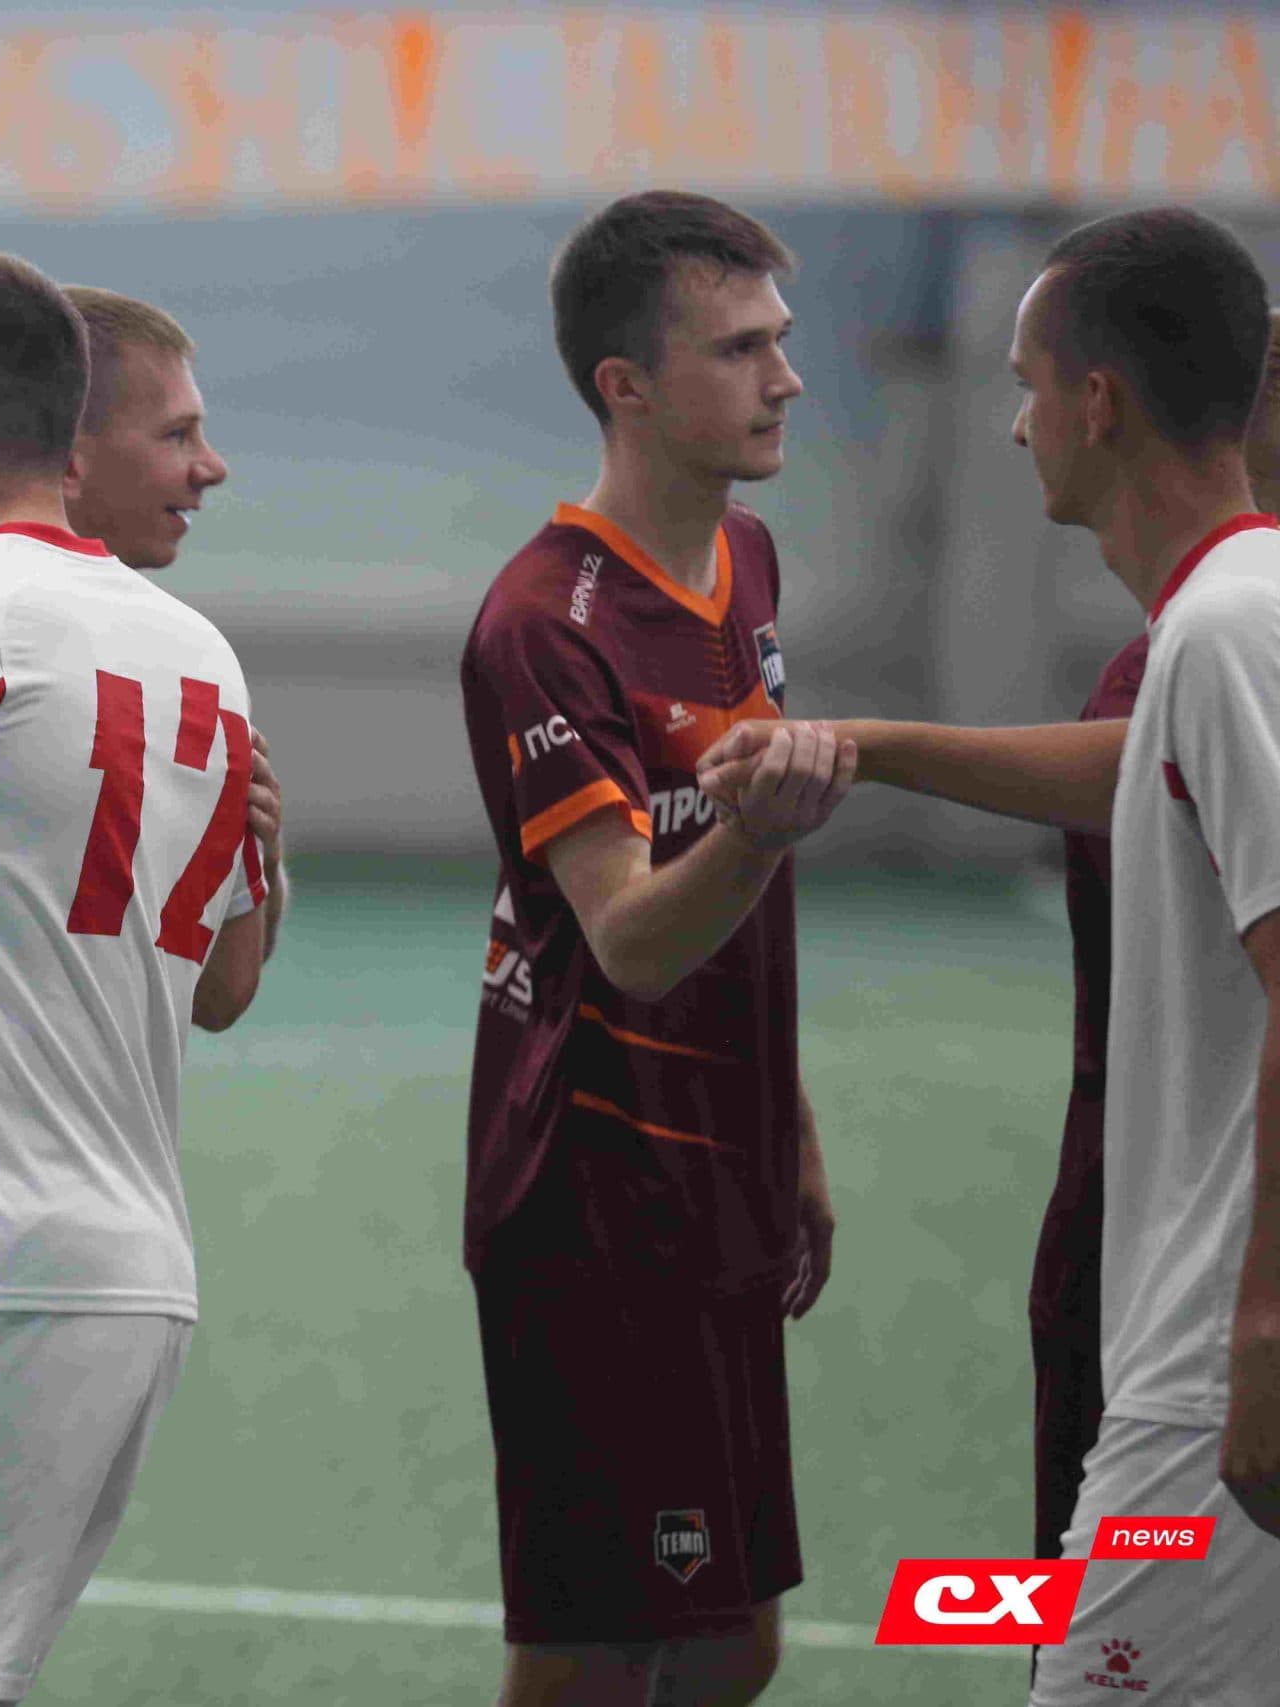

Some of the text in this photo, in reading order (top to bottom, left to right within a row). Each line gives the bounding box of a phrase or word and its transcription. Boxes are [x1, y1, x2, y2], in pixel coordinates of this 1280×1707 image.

[524, 714, 581, 760] ПС
[66, 669, 252, 966] 12
[1084, 1671, 1149, 1692] KELME
